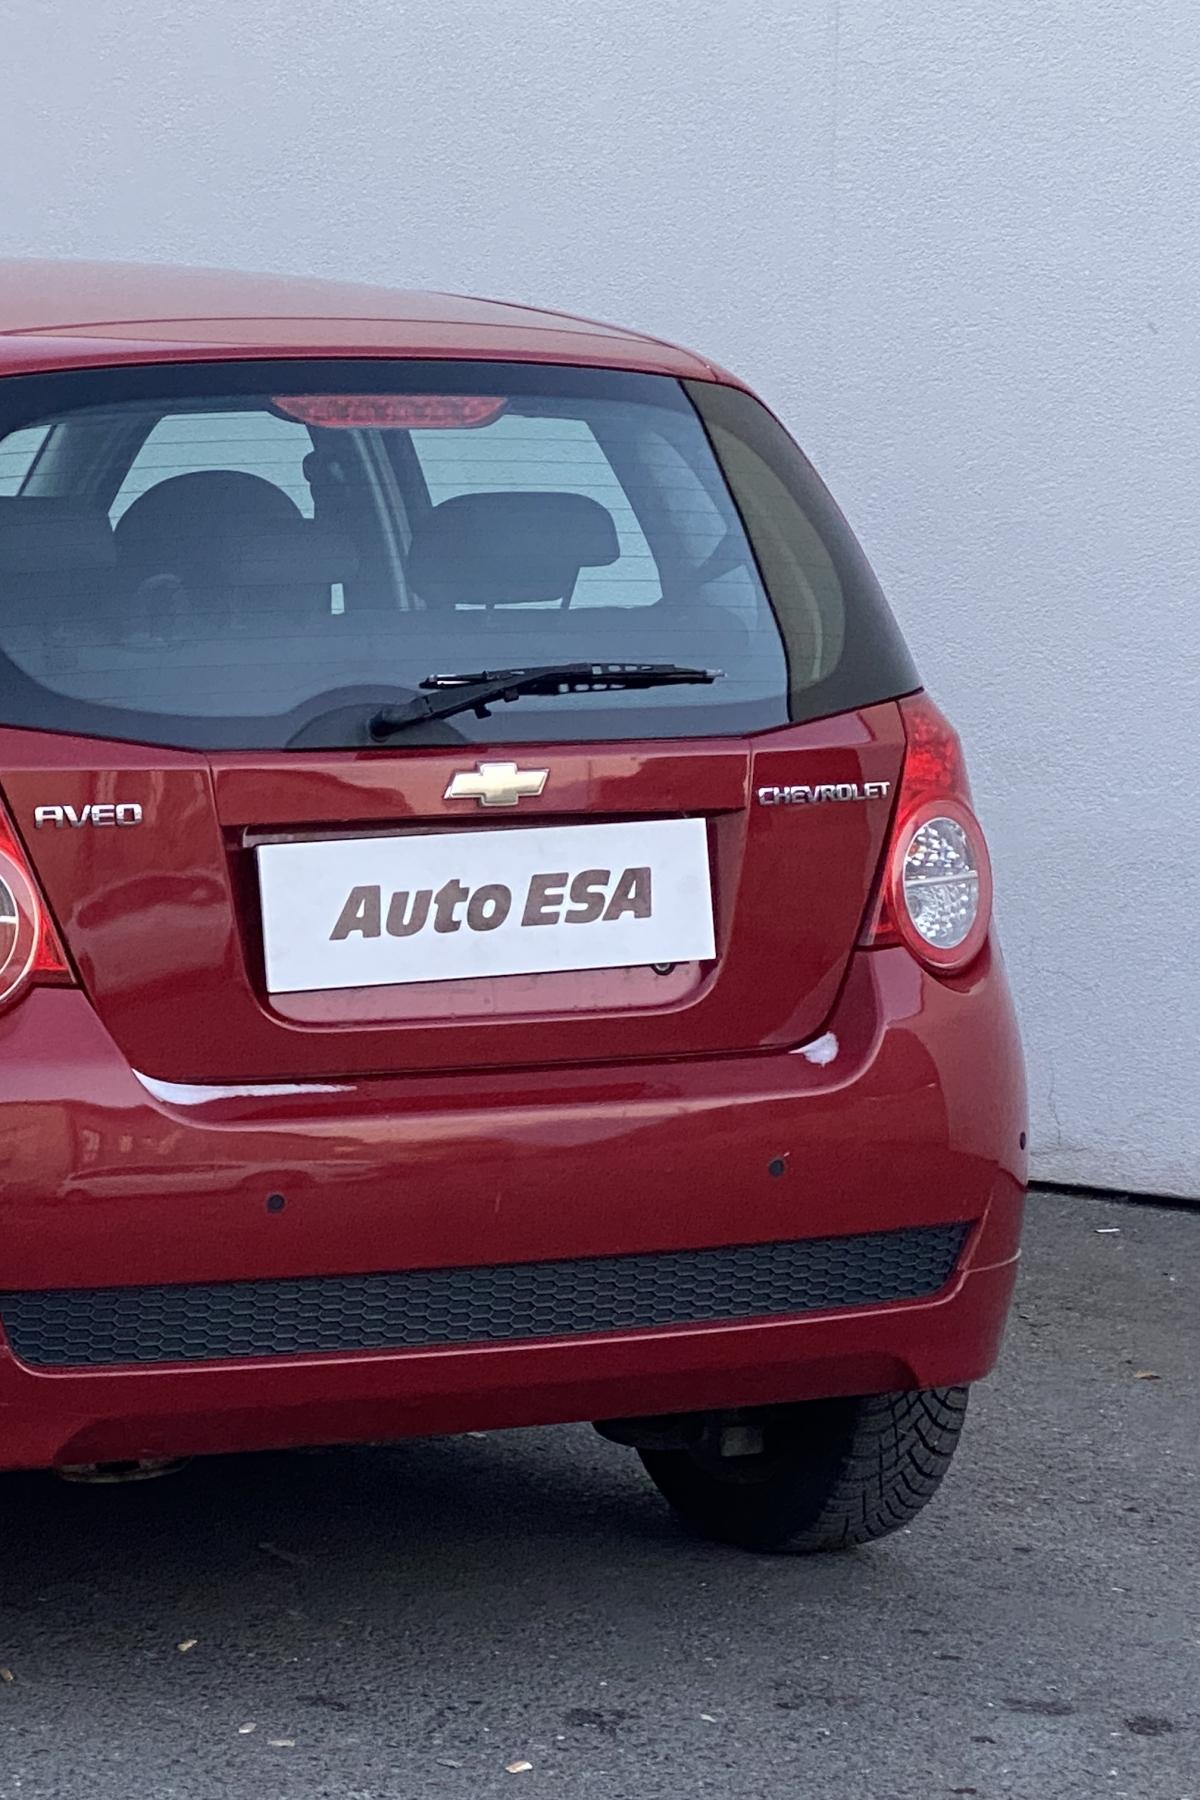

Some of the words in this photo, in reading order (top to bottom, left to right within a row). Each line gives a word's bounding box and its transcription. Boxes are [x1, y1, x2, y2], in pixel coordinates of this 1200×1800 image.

[758, 781, 891, 805] CHEVROLET
[34, 803, 143, 829] AVEO
[329, 878, 511, 941] Auto
[521, 867, 652, 927] ESA
